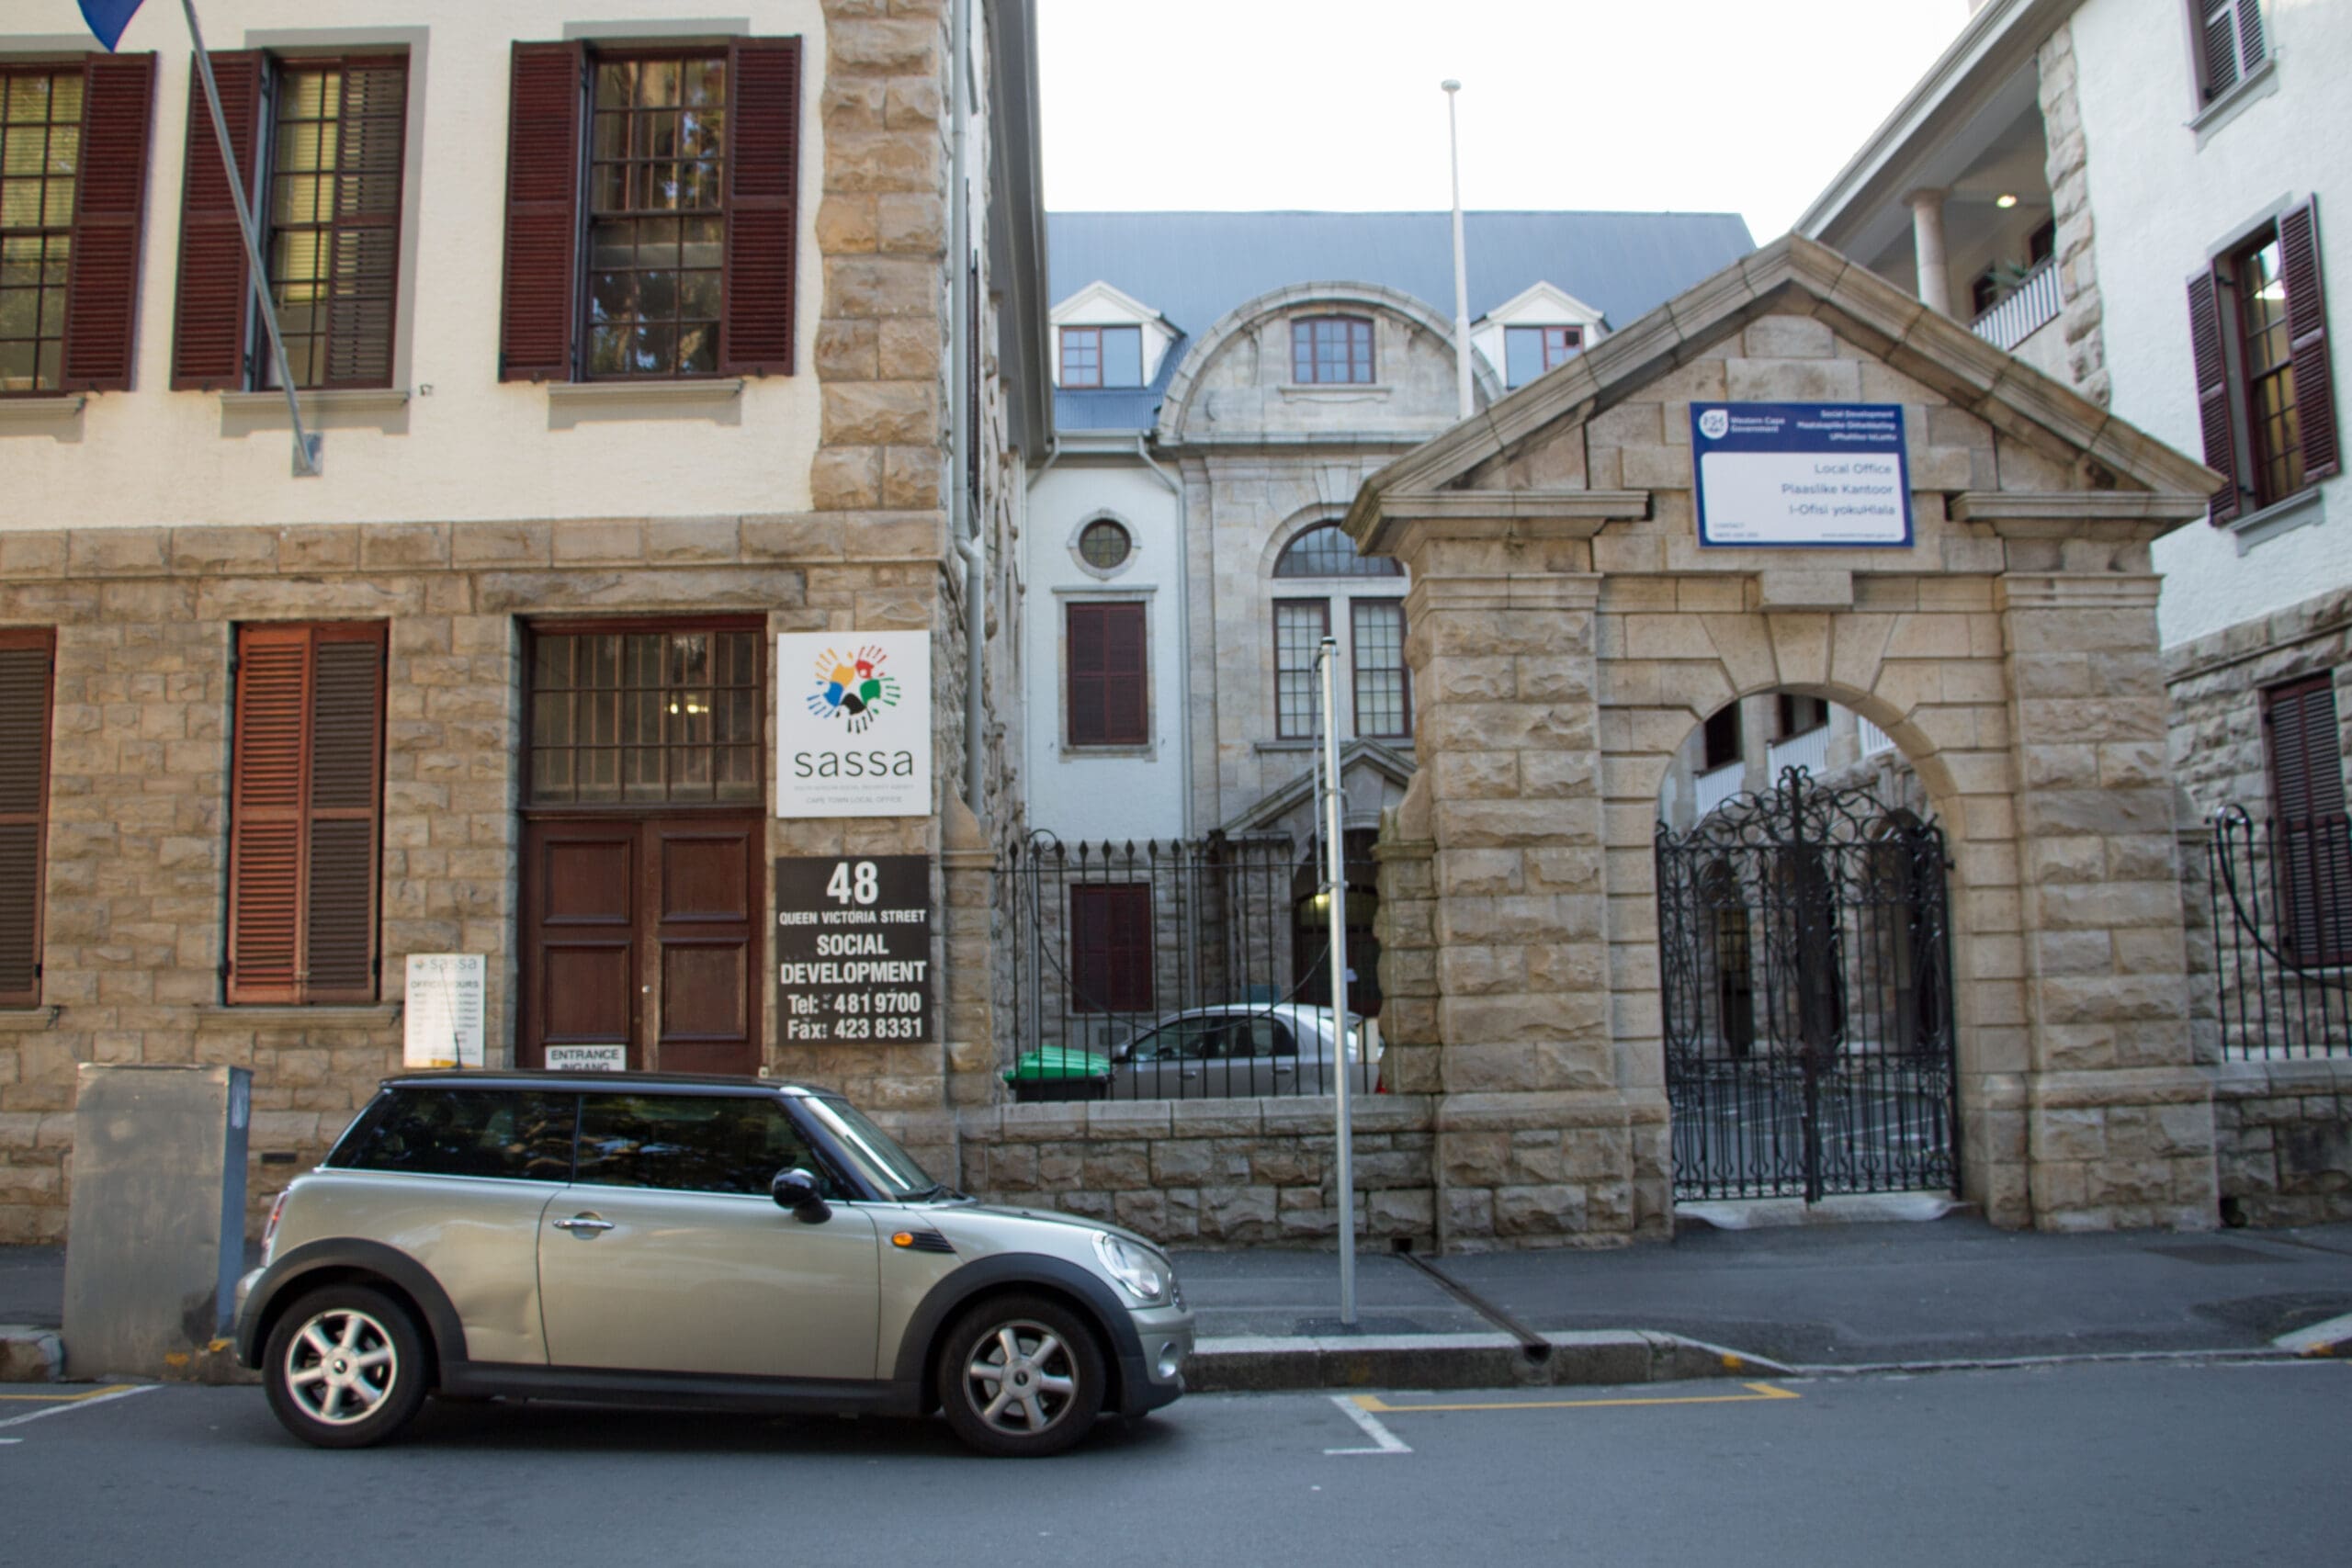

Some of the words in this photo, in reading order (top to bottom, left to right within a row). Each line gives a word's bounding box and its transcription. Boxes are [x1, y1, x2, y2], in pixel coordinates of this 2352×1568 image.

[1730, 417, 1762, 425] Western
[1764, 417, 1785, 426] Cape
[1821, 410, 1843, 419] Social
[1845, 410, 1894, 420] Development
[1730, 425, 1779, 434] Government
[1815, 463, 1849, 475] Local
[1854, 462, 1892, 475] Office
[1781, 483, 1838, 495] Plaaslike
[1842, 483, 1894, 495] Kantoor
[794, 750, 913, 778] sassa
[807, 796, 825, 805] CAPE
[828, 796, 849, 805] TOWN
[851, 795, 873, 804] LOCAL
[876, 795, 902, 804] OFFICE
[826, 861, 879, 906] 48
[779, 911, 818, 926] QUEEN
[821, 910, 876, 925] VICTORIA
[880, 909, 926, 923] STREET
[817, 933, 889, 956] SOCIAL
[429, 957, 477, 970] sasa
[780, 960, 927, 985] DEVELOPMENT
[447, 979, 479, 988] OURS
[875, 992, 922, 1013] 9700
[787, 1020, 828, 1040] Fax:
[834, 1019, 870, 1038] 423
[875, 1017, 922, 1038] 8331
[550, 1048, 619, 1060] ENTRANCE
